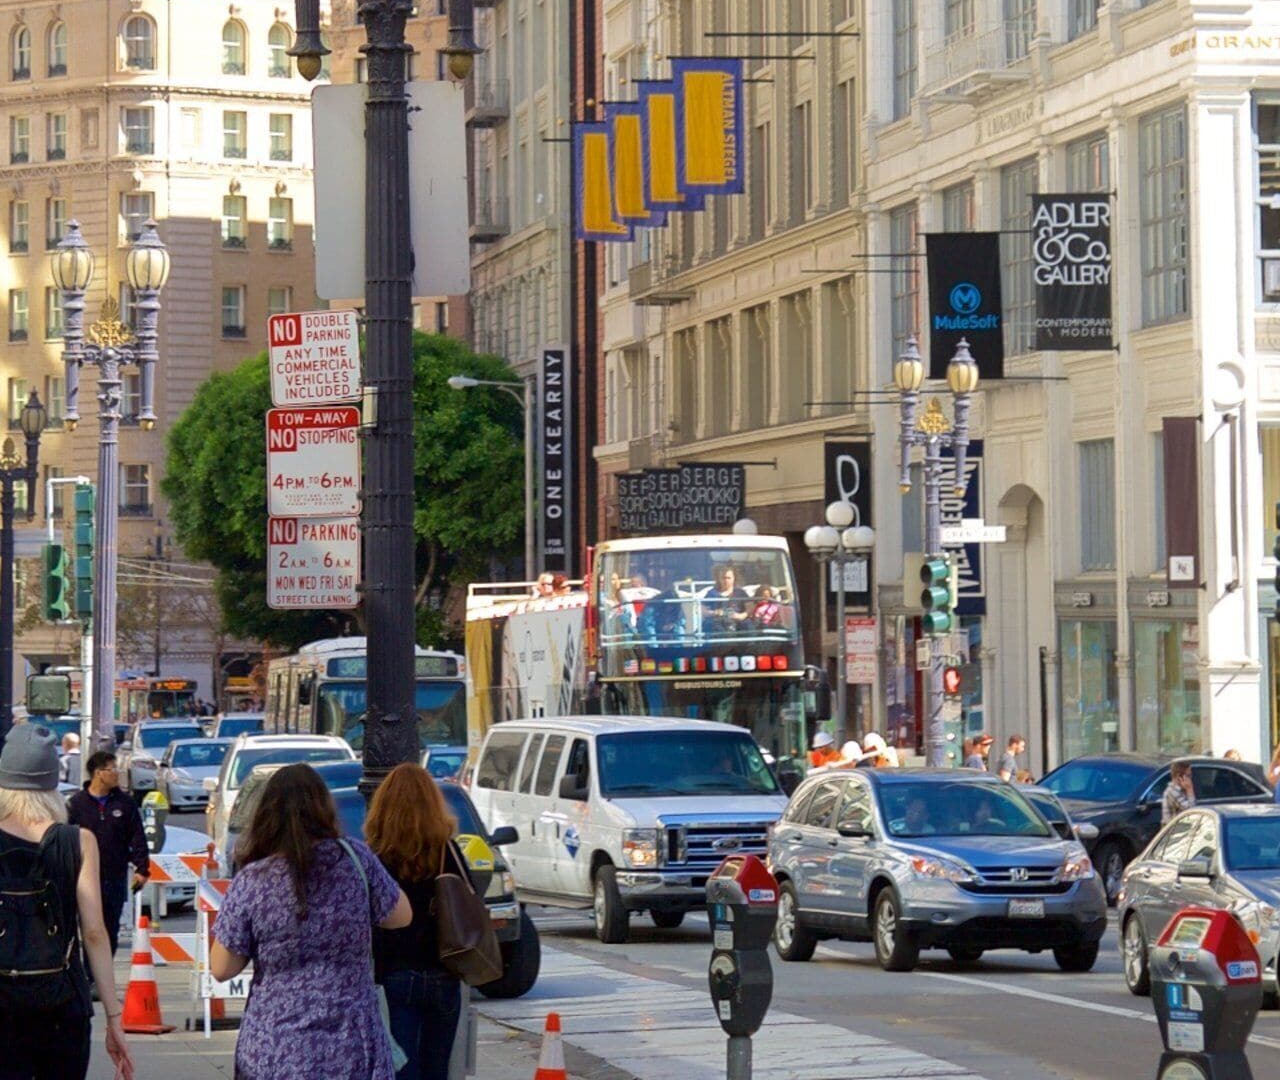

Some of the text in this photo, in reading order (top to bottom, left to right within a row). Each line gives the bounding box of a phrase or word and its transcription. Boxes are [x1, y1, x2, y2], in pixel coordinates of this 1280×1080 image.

[1032, 202, 1111, 227] ADLER
[1034, 264, 1112, 285] GALLERY
[273, 314, 350, 343] NO DOUBLE
[934, 314, 999, 330] MuleSoft
[1035, 318, 1112, 329] CONTEMPORARY
[306, 328, 352, 342] PARKING
[1060, 328, 1113, 338] MODERN
[285, 345, 347, 360] ANY TIME
[276, 358, 356, 374] COMMERCIAL
[285, 371, 350, 386] VEHICLES
[285, 385, 351, 399] INCLUDED
[277, 411, 349, 426] TOW-AWAY
[270, 428, 356, 449] NO STOPPING
[546, 355, 562, 519] ONE KEARNY
[682, 468, 741, 486] SERGE
[682, 486, 741, 505] SOROKKO
[683, 505, 740, 523] GALLERY
[272, 519, 357, 543] NO PARKING
[275, 575, 354, 590] MON WED FRI SAT
[275, 594, 353, 605] STREET CLEANING
